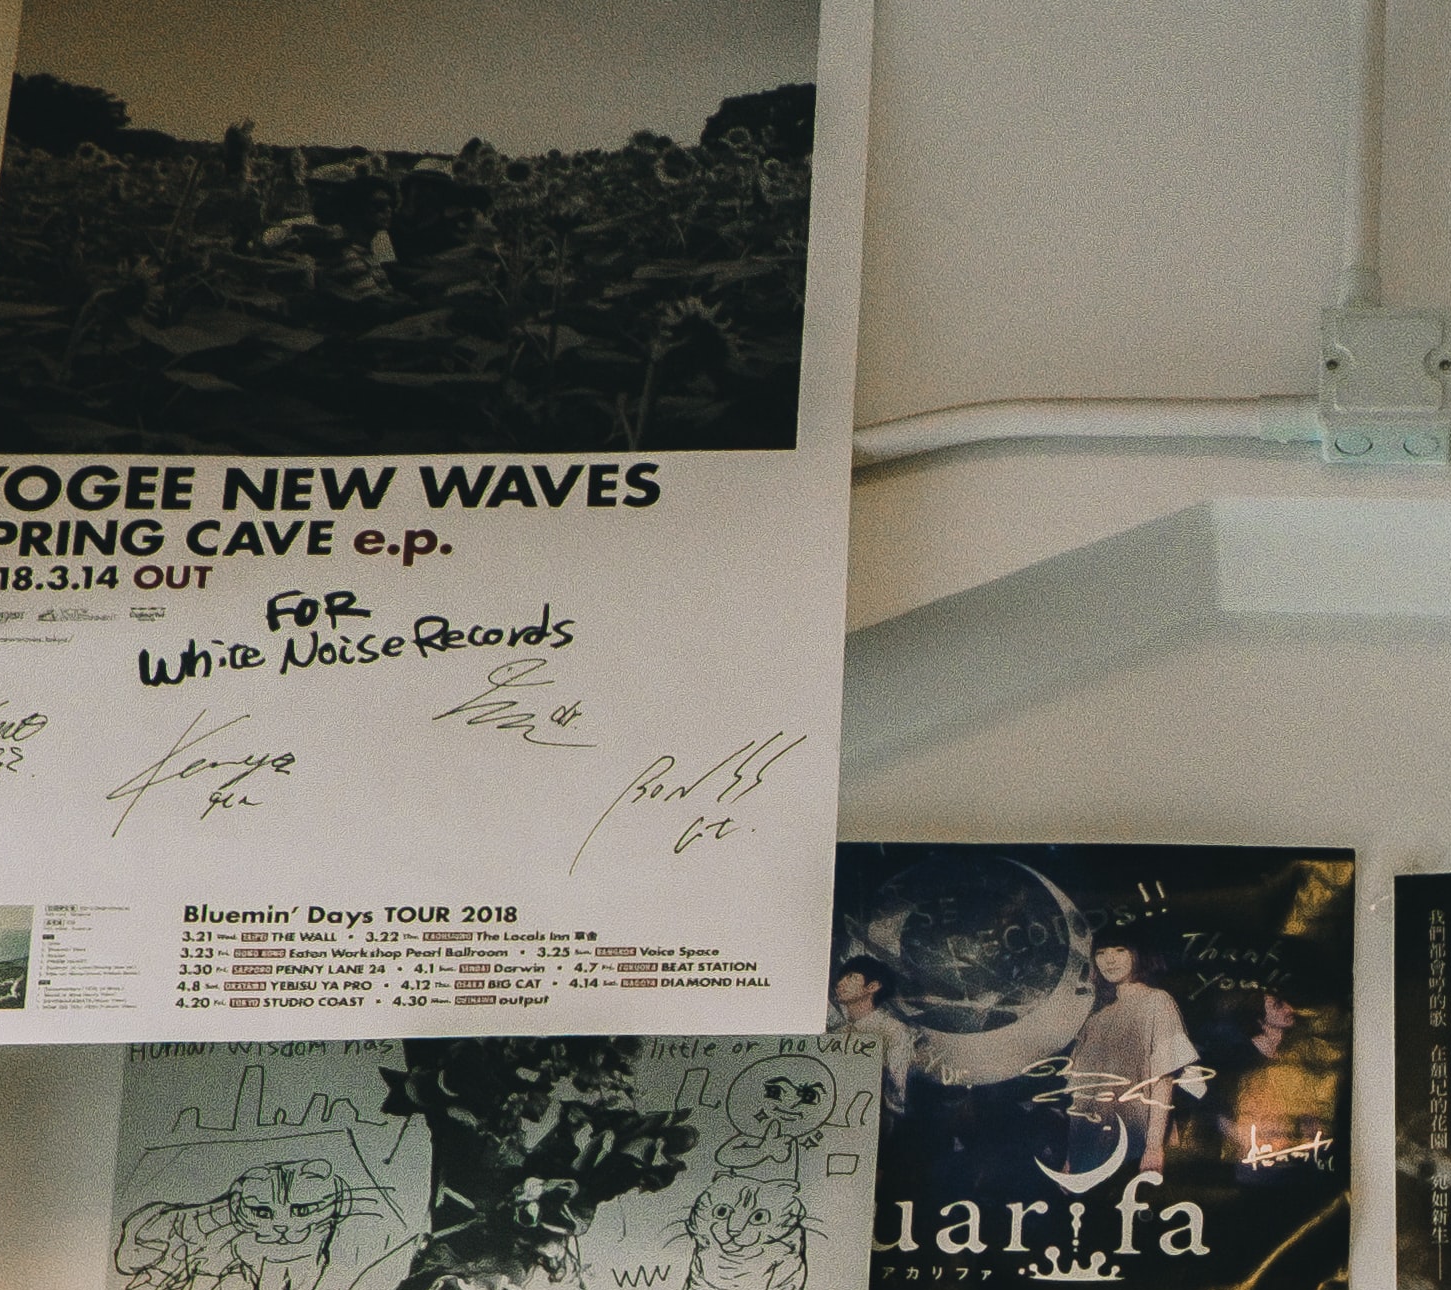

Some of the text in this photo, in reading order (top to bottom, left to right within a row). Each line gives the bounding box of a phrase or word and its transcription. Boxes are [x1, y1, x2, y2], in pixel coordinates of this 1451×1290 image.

[223, 466, 397, 512] NEW
[419, 462, 662, 508] WAVES
[185, 519, 336, 557] CAVE
[352, 528, 454, 567] e.p.
[133, 564, 215, 590] OUT
[266, 590, 372, 632] FOR
[139, 602, 576, 688] White Noise Records
[306, 904, 519, 929] Days TOUR 2018
[299, 931, 338, 943] WALL
[331, 946, 721, 962] Workshop 3.25 Voice Space
[275, 961, 758, 975] PENNY LANE 4.7 BEAT STATION
[342, 976, 772, 991] PRO CAT 4.14 DIAMOND HALL
[262, 995, 365, 1009] STUDIO COAST
